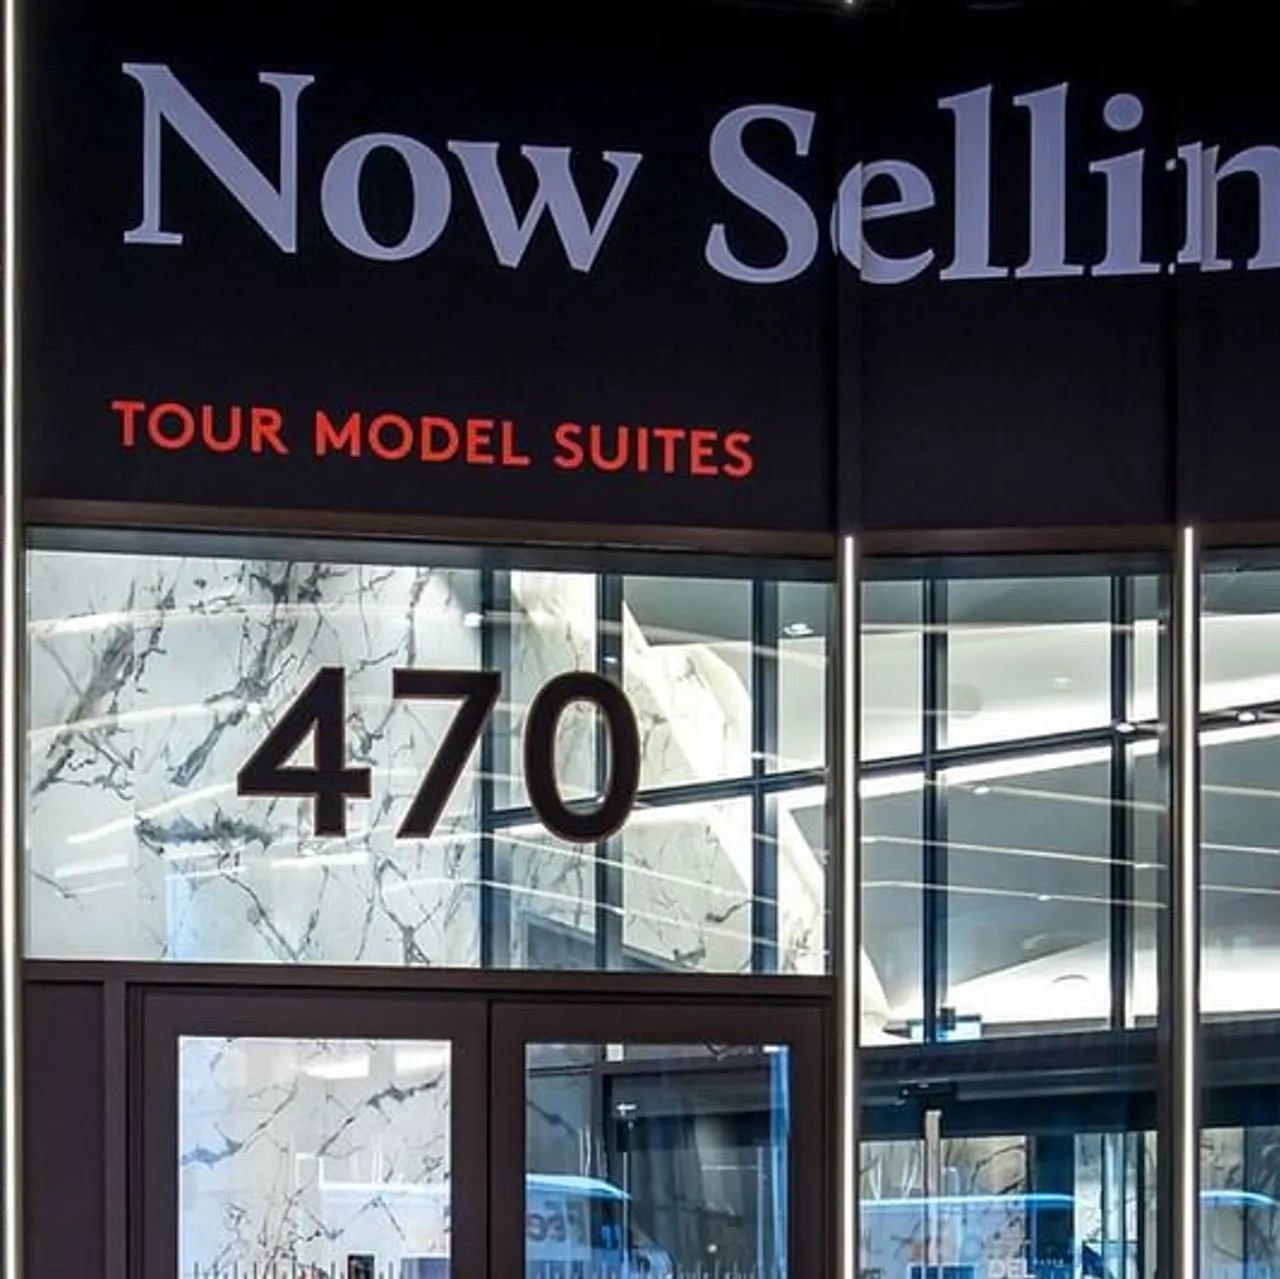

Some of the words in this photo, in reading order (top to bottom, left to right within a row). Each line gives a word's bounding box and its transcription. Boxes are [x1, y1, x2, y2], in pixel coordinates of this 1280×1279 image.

[122, 63, 642, 272] Now
[111, 401, 288, 454] TOUR
[315, 410, 530, 466] MODEL
[553, 422, 753, 477] SUITES
[237, 667, 641, 843] 470
